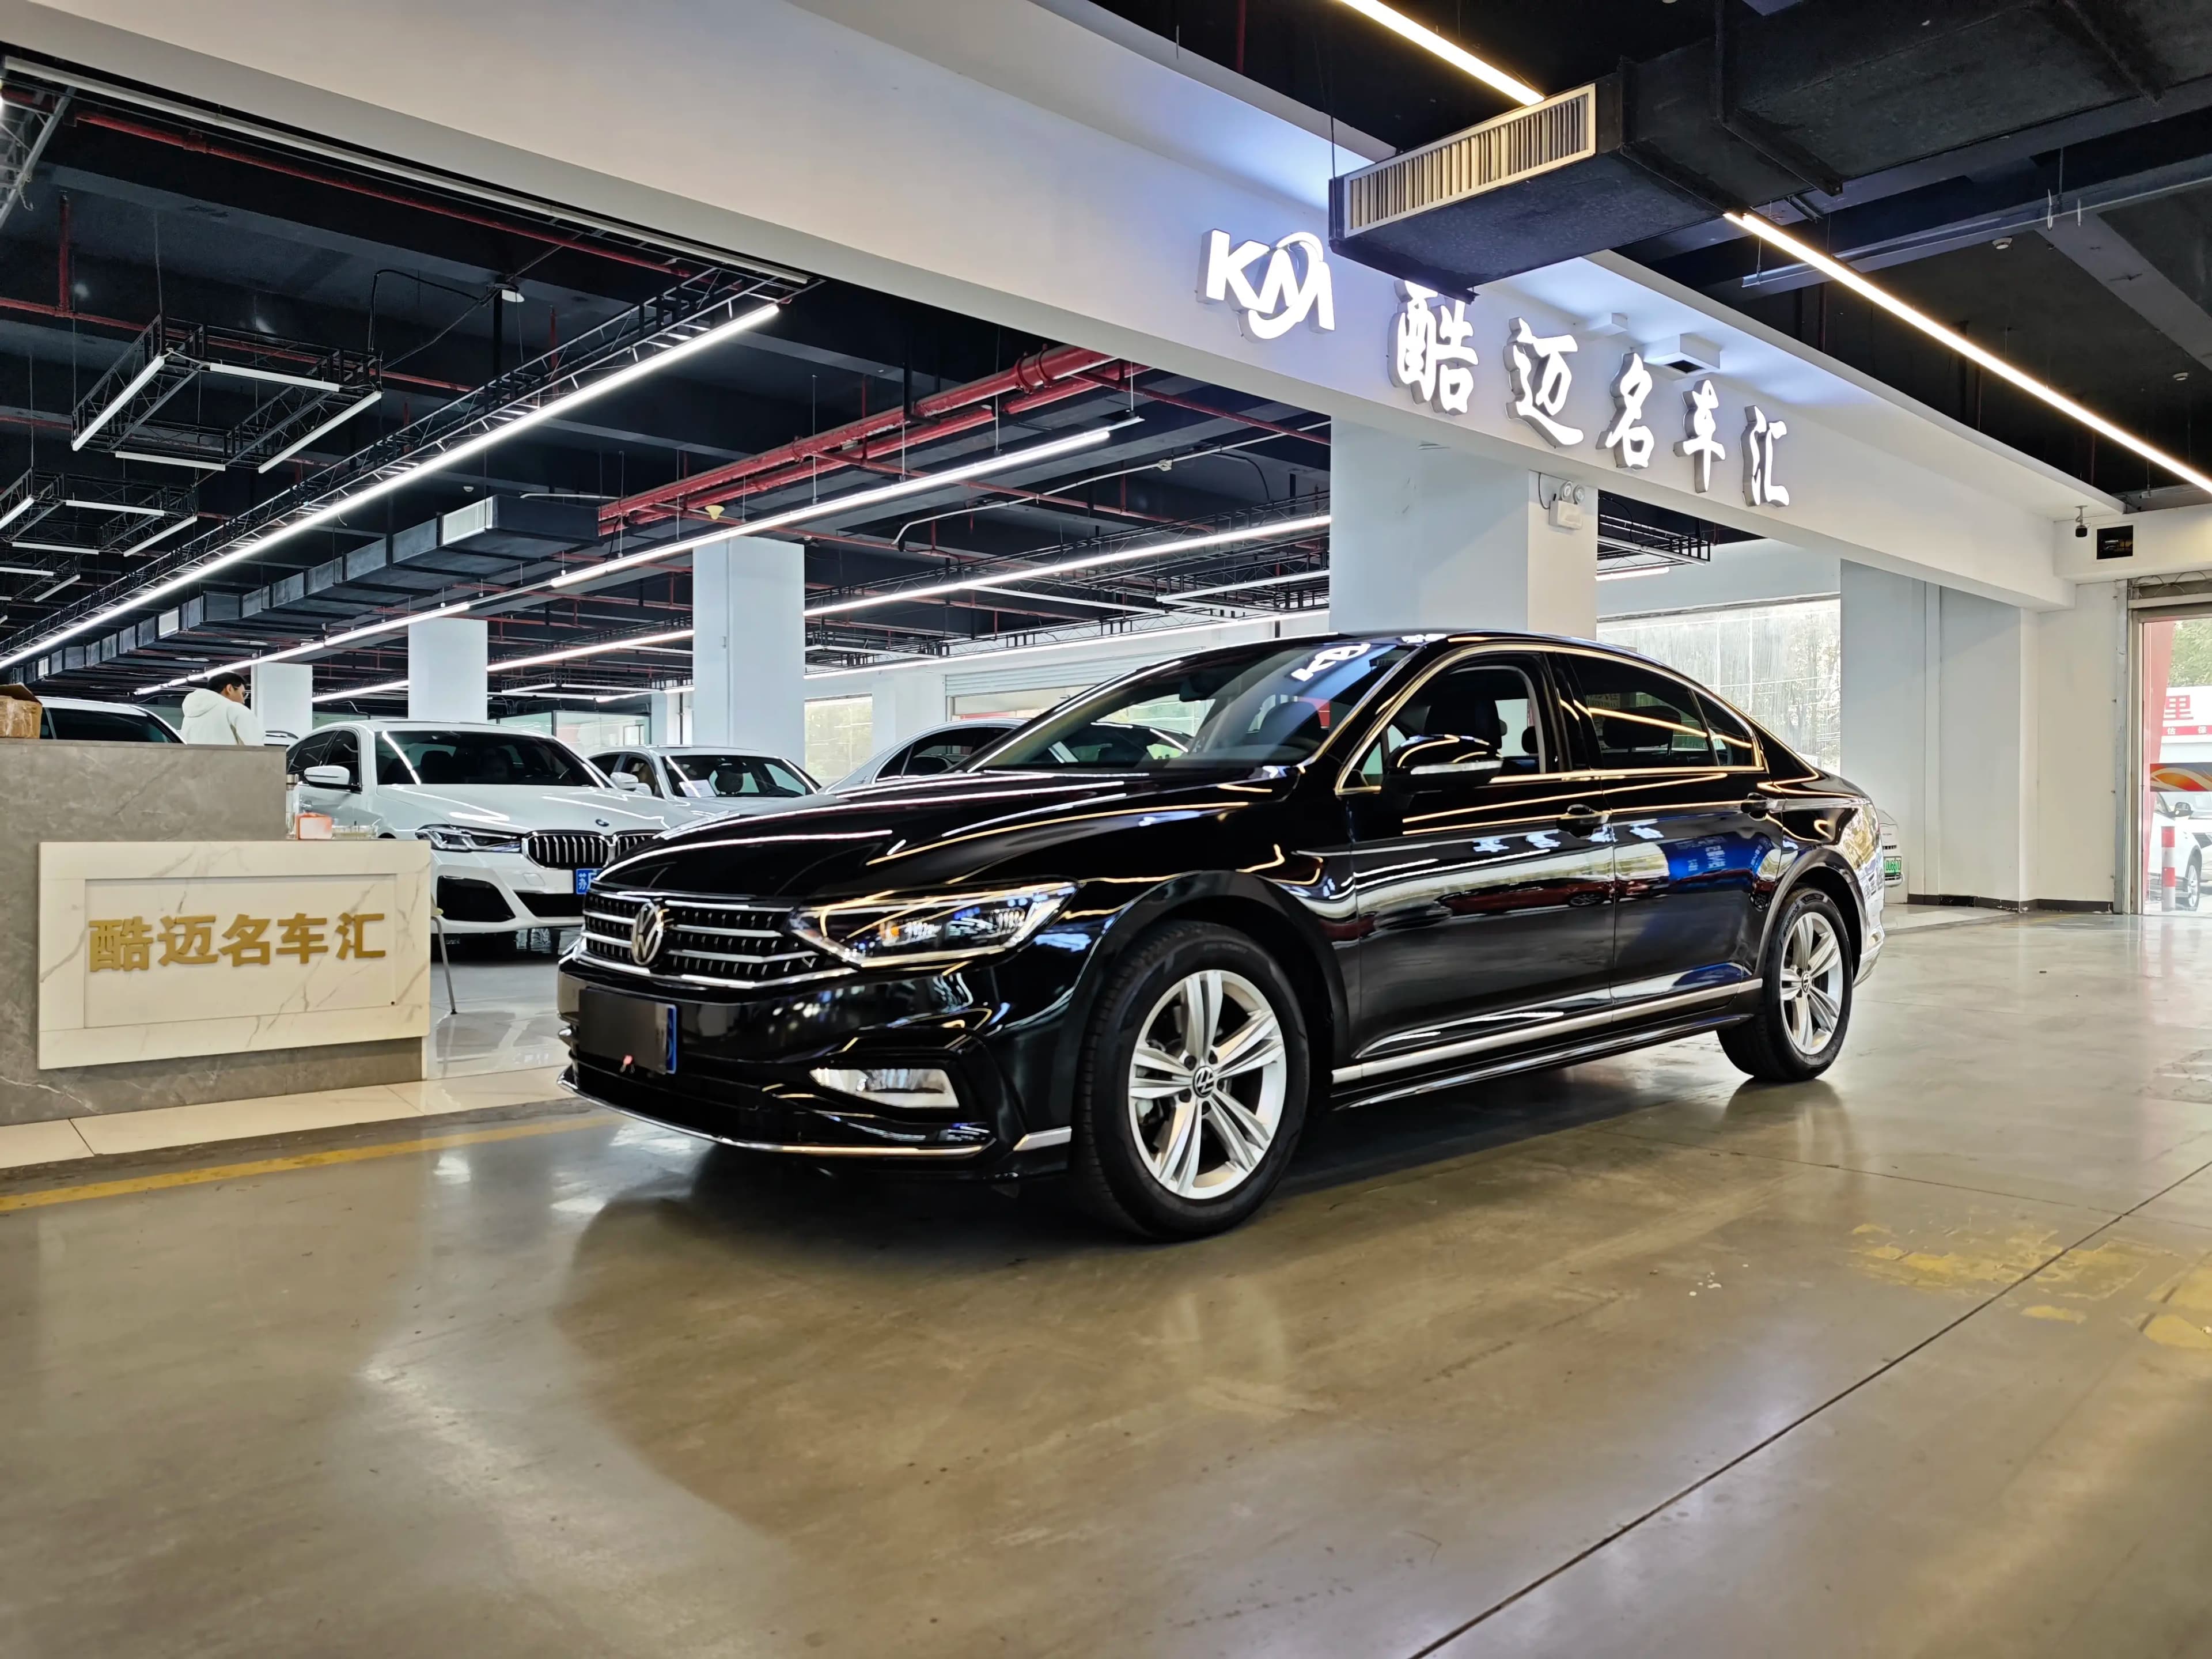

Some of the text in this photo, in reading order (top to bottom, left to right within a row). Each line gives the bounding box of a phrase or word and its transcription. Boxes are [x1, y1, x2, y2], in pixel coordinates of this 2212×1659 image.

[1392, 281, 1790, 506] 酷迈名车汇
[88, 913, 387, 973] 酷迈名车汇
